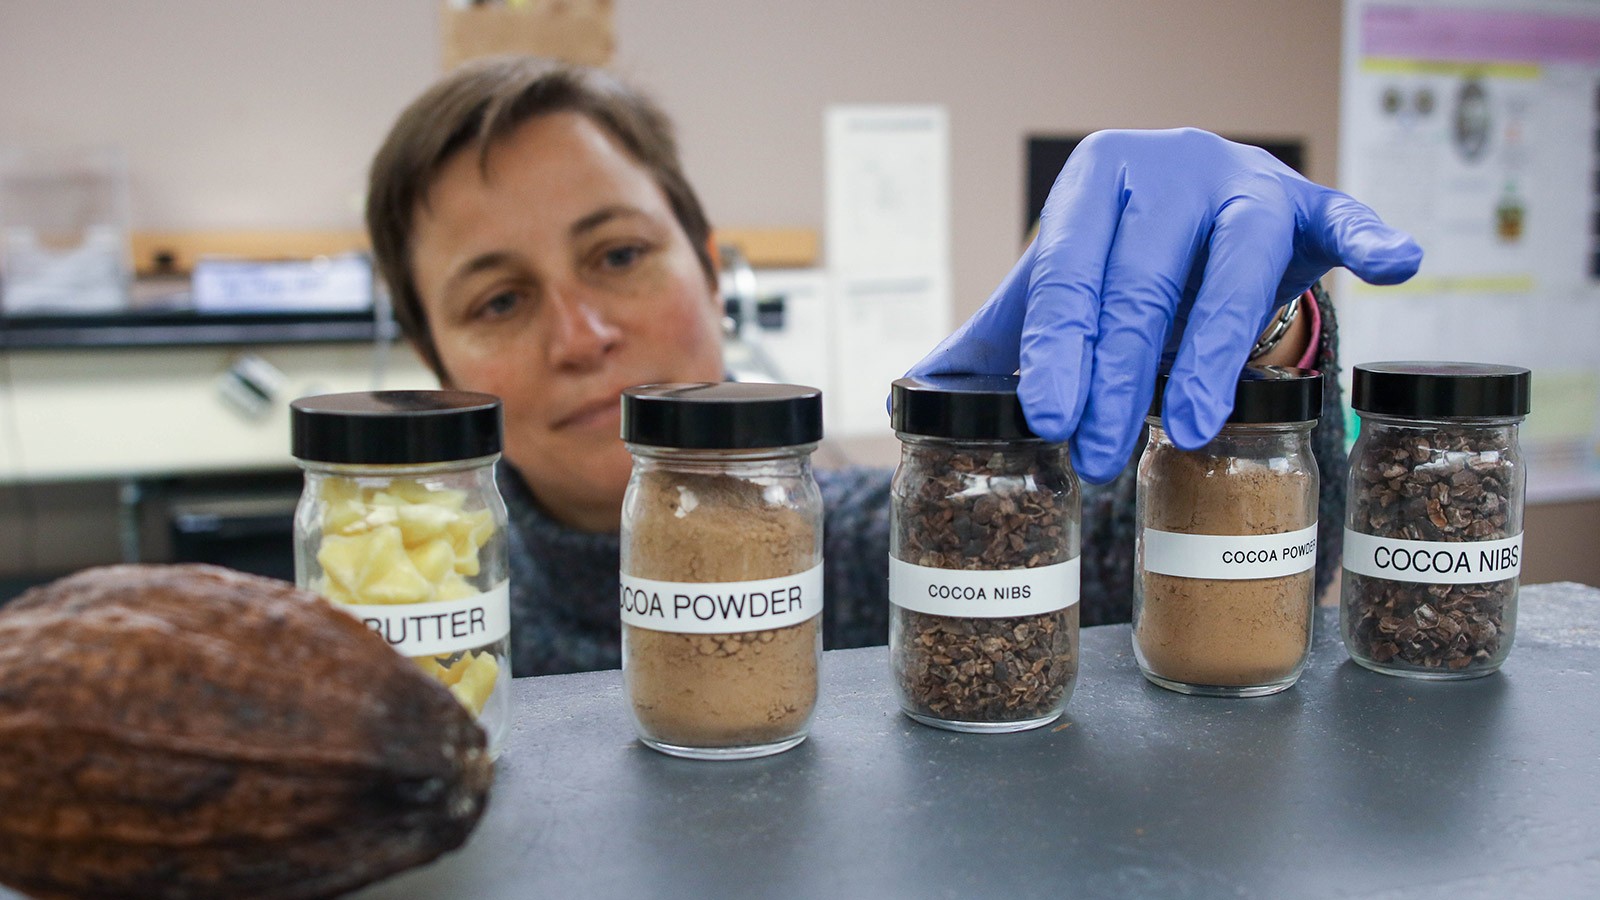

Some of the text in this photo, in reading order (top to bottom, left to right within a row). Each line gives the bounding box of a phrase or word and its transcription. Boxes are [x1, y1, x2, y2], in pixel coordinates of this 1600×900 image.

[1222, 550, 1278, 564] COCOA
[1374, 545, 1519, 573] COCOA NIBS
[674, 585, 802, 621] POWDER
[928, 584, 1032, 600] COCOA NIBS
